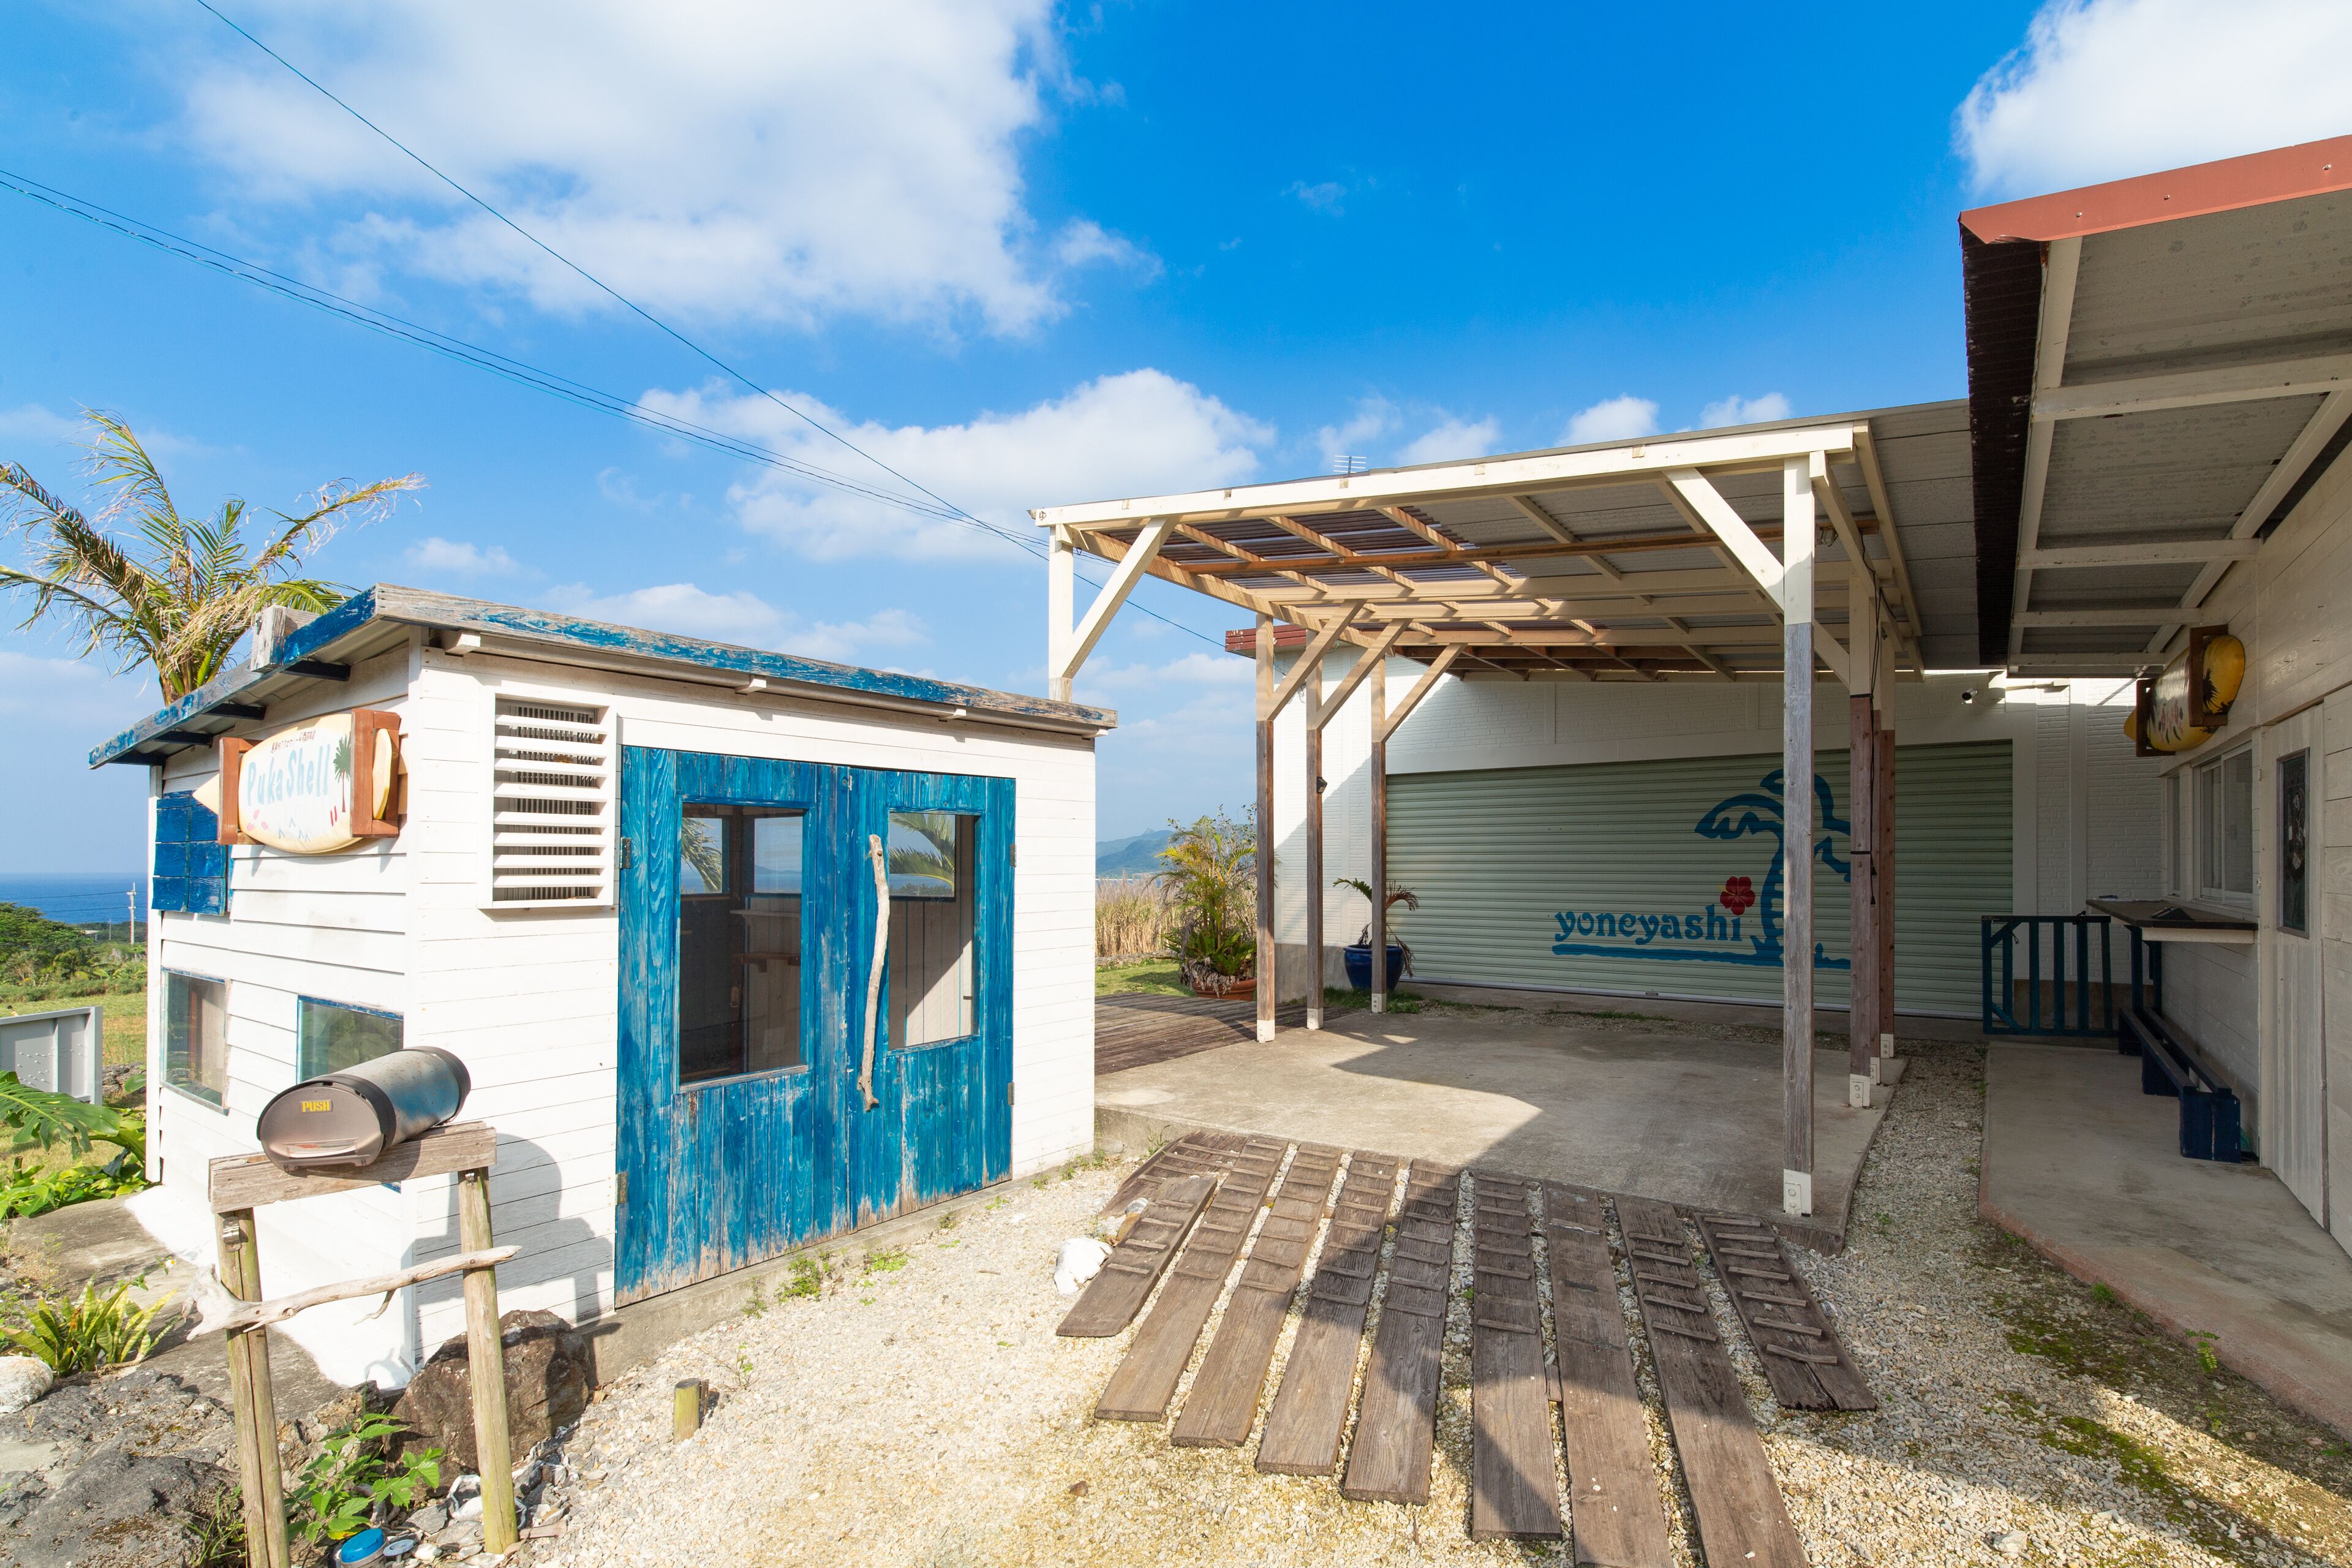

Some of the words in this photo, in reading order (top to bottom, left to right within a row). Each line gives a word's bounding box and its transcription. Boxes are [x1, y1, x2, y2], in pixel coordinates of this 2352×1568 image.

[247, 756, 283, 806] Puka
[285, 744, 331, 799] Shell
[1554, 903, 1743, 945] yoneyashi
[301, 1099, 330, 1113] PUSH
